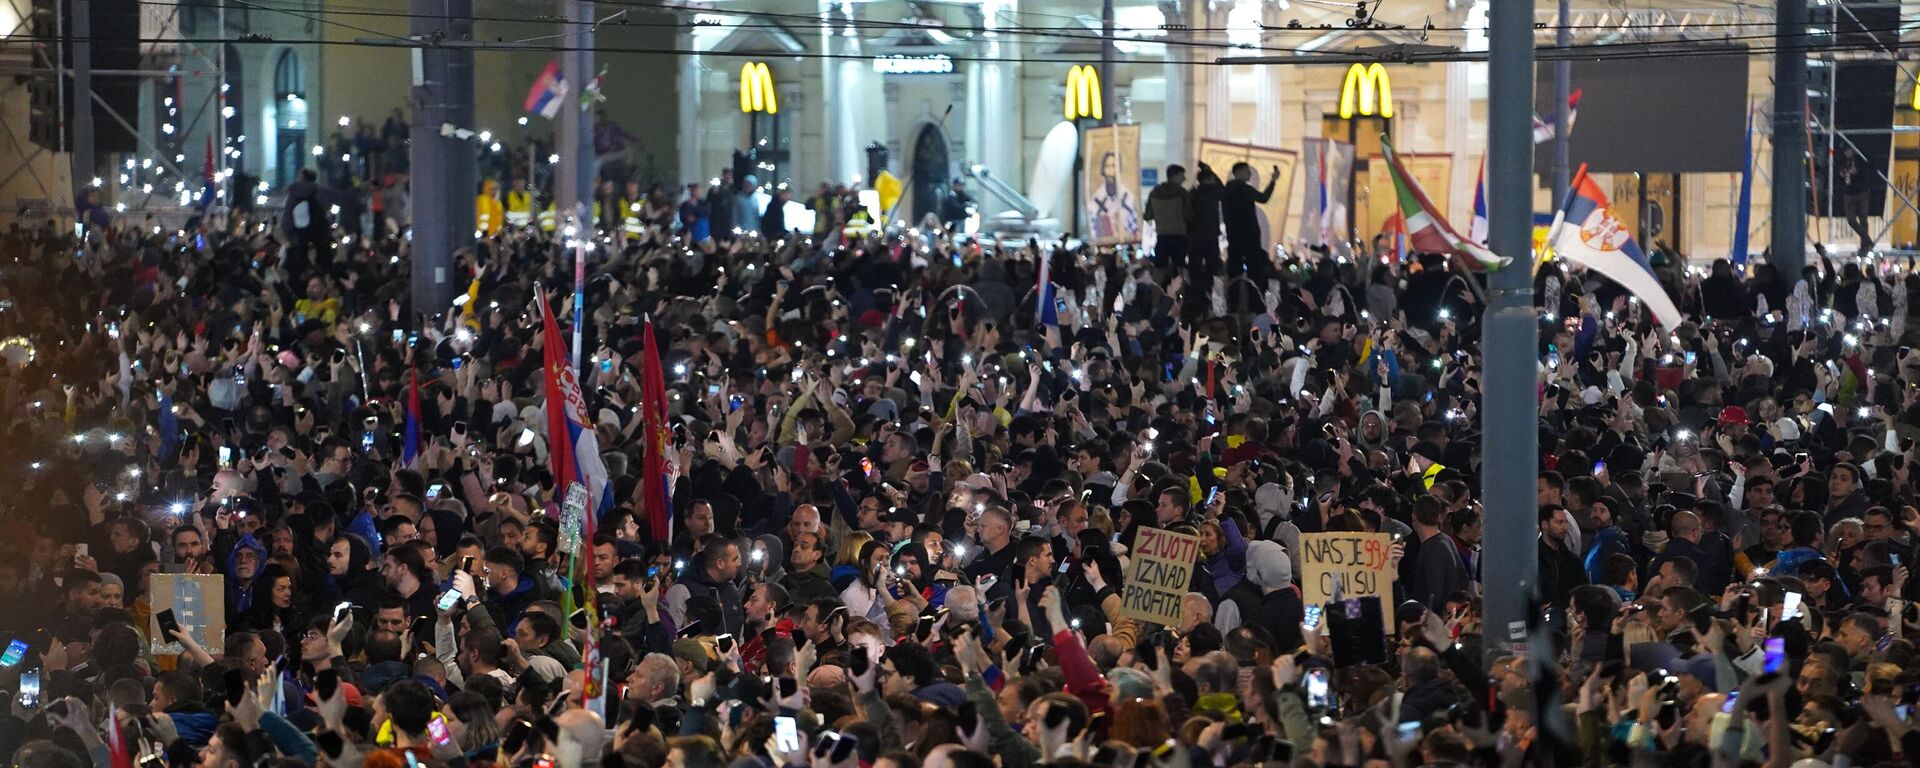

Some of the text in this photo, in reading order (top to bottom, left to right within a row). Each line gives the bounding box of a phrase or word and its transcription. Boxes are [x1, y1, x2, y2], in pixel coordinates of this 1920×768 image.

[1136, 528, 1198, 564] ŽIVOTI
[1304, 538, 1344, 565] NAS
[1347, 538, 1365, 567] JE
[1134, 558, 1187, 590] IZNAD
[1354, 570, 1377, 595] SU
[1122, 584, 1182, 619] PROFITA
